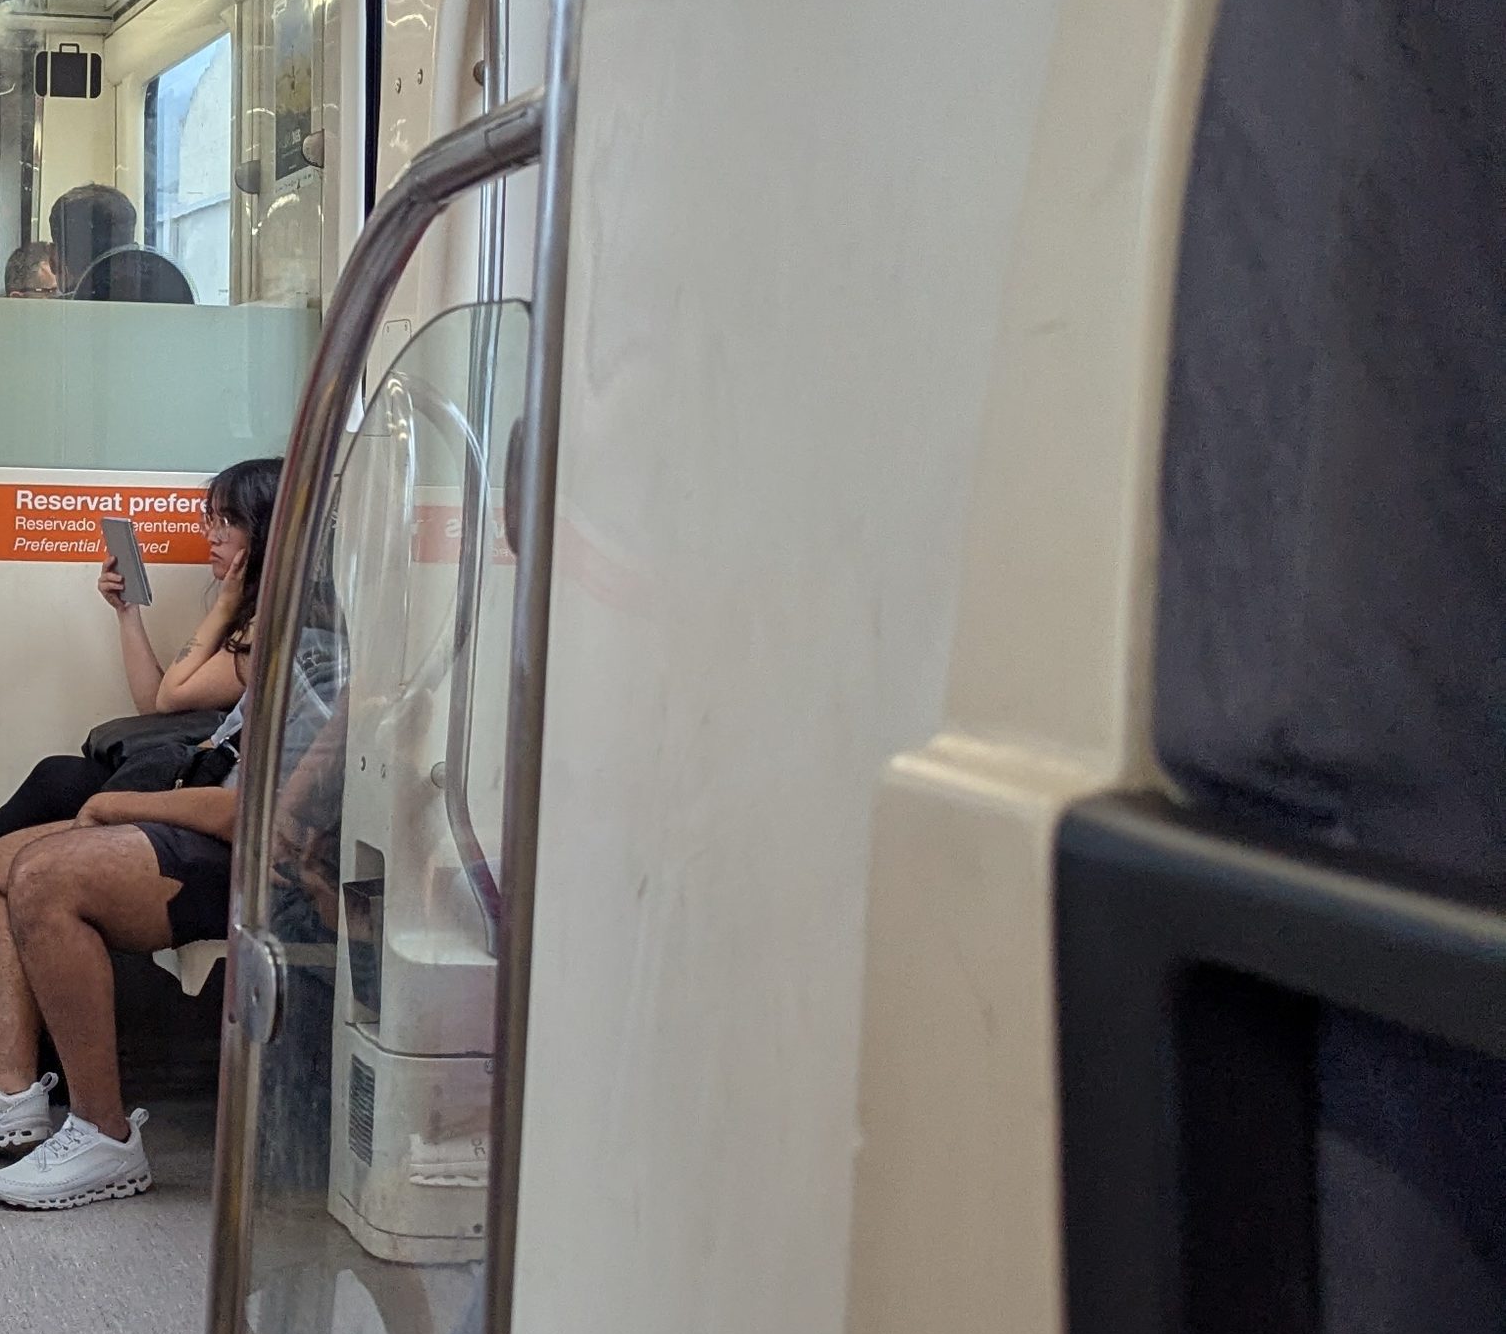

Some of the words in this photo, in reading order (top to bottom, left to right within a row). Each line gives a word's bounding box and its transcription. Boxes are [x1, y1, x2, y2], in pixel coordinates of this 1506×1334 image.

[15, 490, 123, 511] Reservat
[15, 516, 96, 531] Reservado
[13, 538, 101, 553] Preferential
